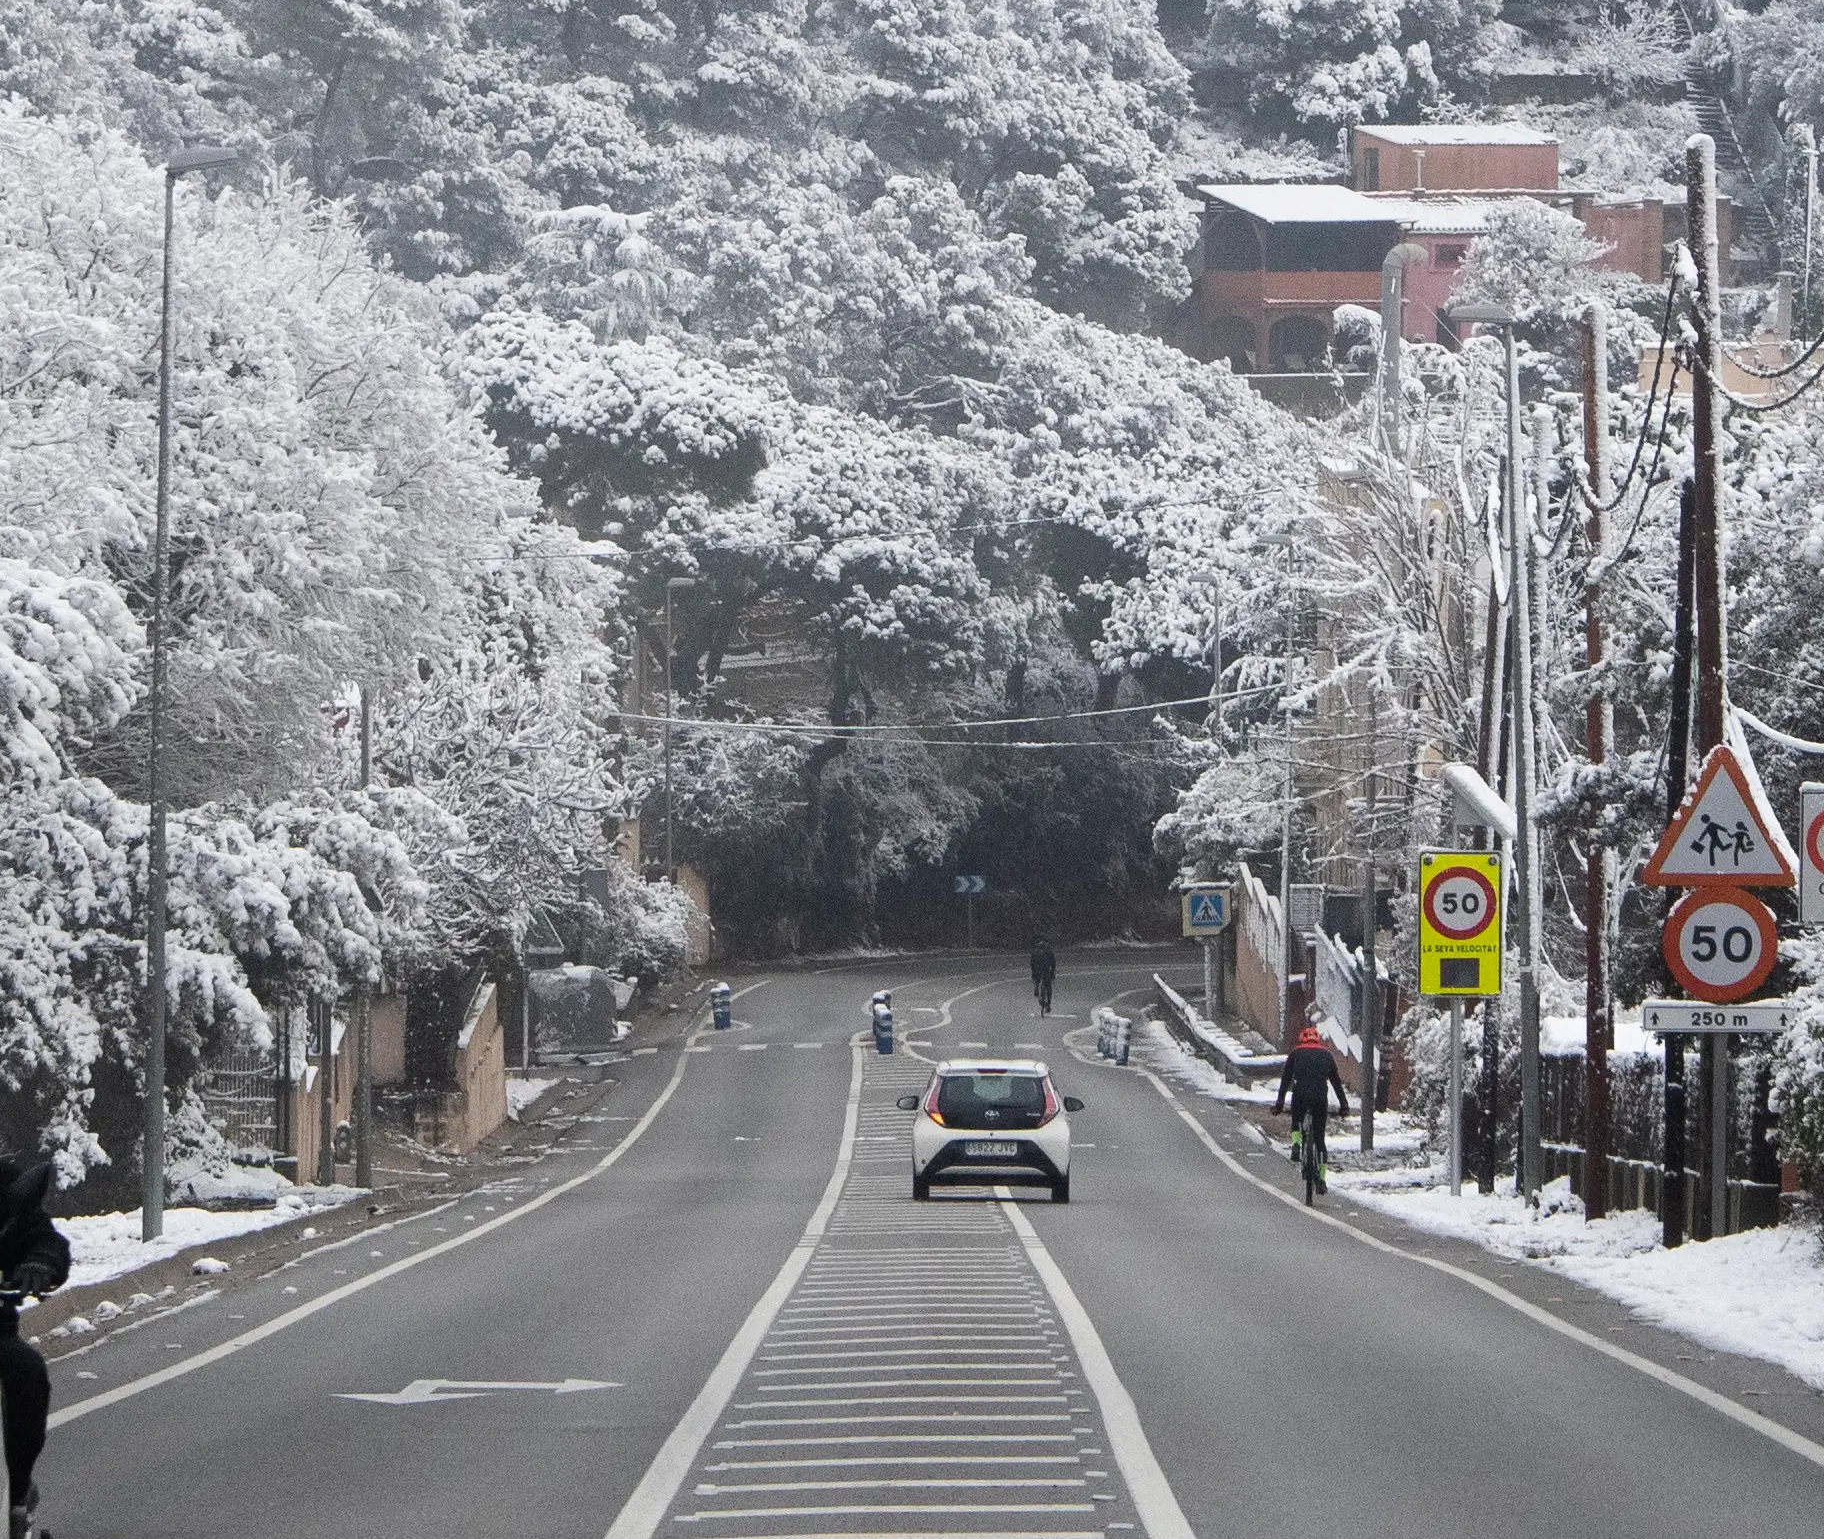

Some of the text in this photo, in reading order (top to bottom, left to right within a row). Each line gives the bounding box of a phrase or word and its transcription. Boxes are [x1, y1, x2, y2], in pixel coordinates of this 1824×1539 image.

[1442, 892, 1480, 915] 50
[1423, 945, 1497, 953] LA SEVA VELOCITAT
[1691, 925, 1753, 964] 50
[1690, 1011, 1748, 1027] 250 m
